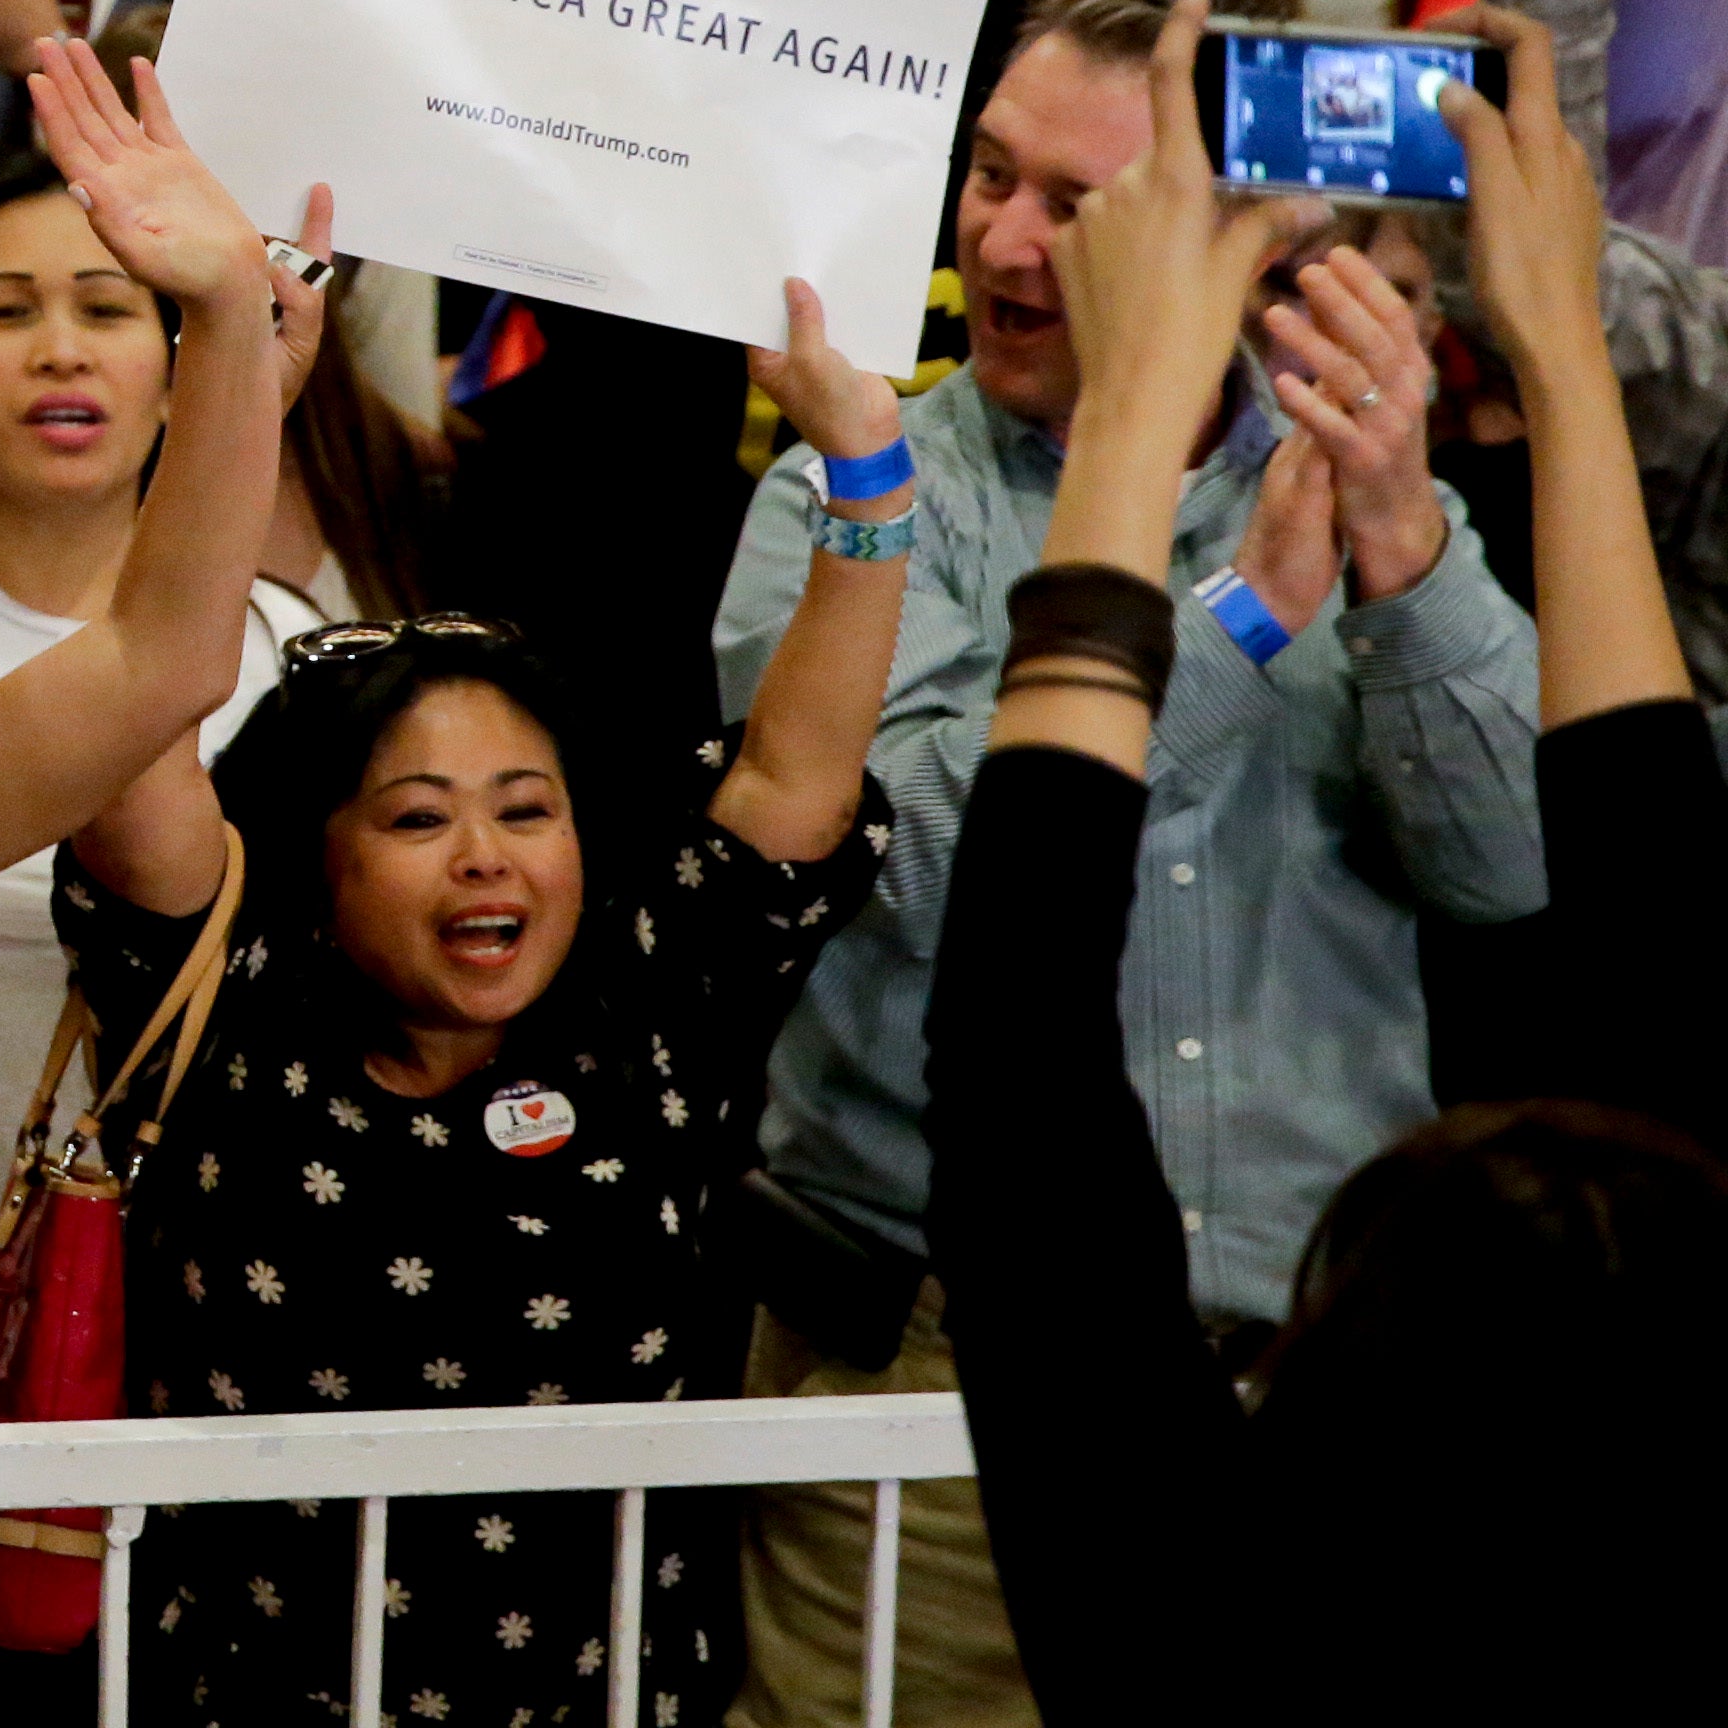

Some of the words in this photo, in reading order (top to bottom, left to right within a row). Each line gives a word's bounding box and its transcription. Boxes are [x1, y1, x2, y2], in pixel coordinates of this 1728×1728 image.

[771, 28, 950, 101] AGAIN!
[425, 93, 691, 168] www.DonaldJTrump.com
[506, 1104, 519, 1126] I
